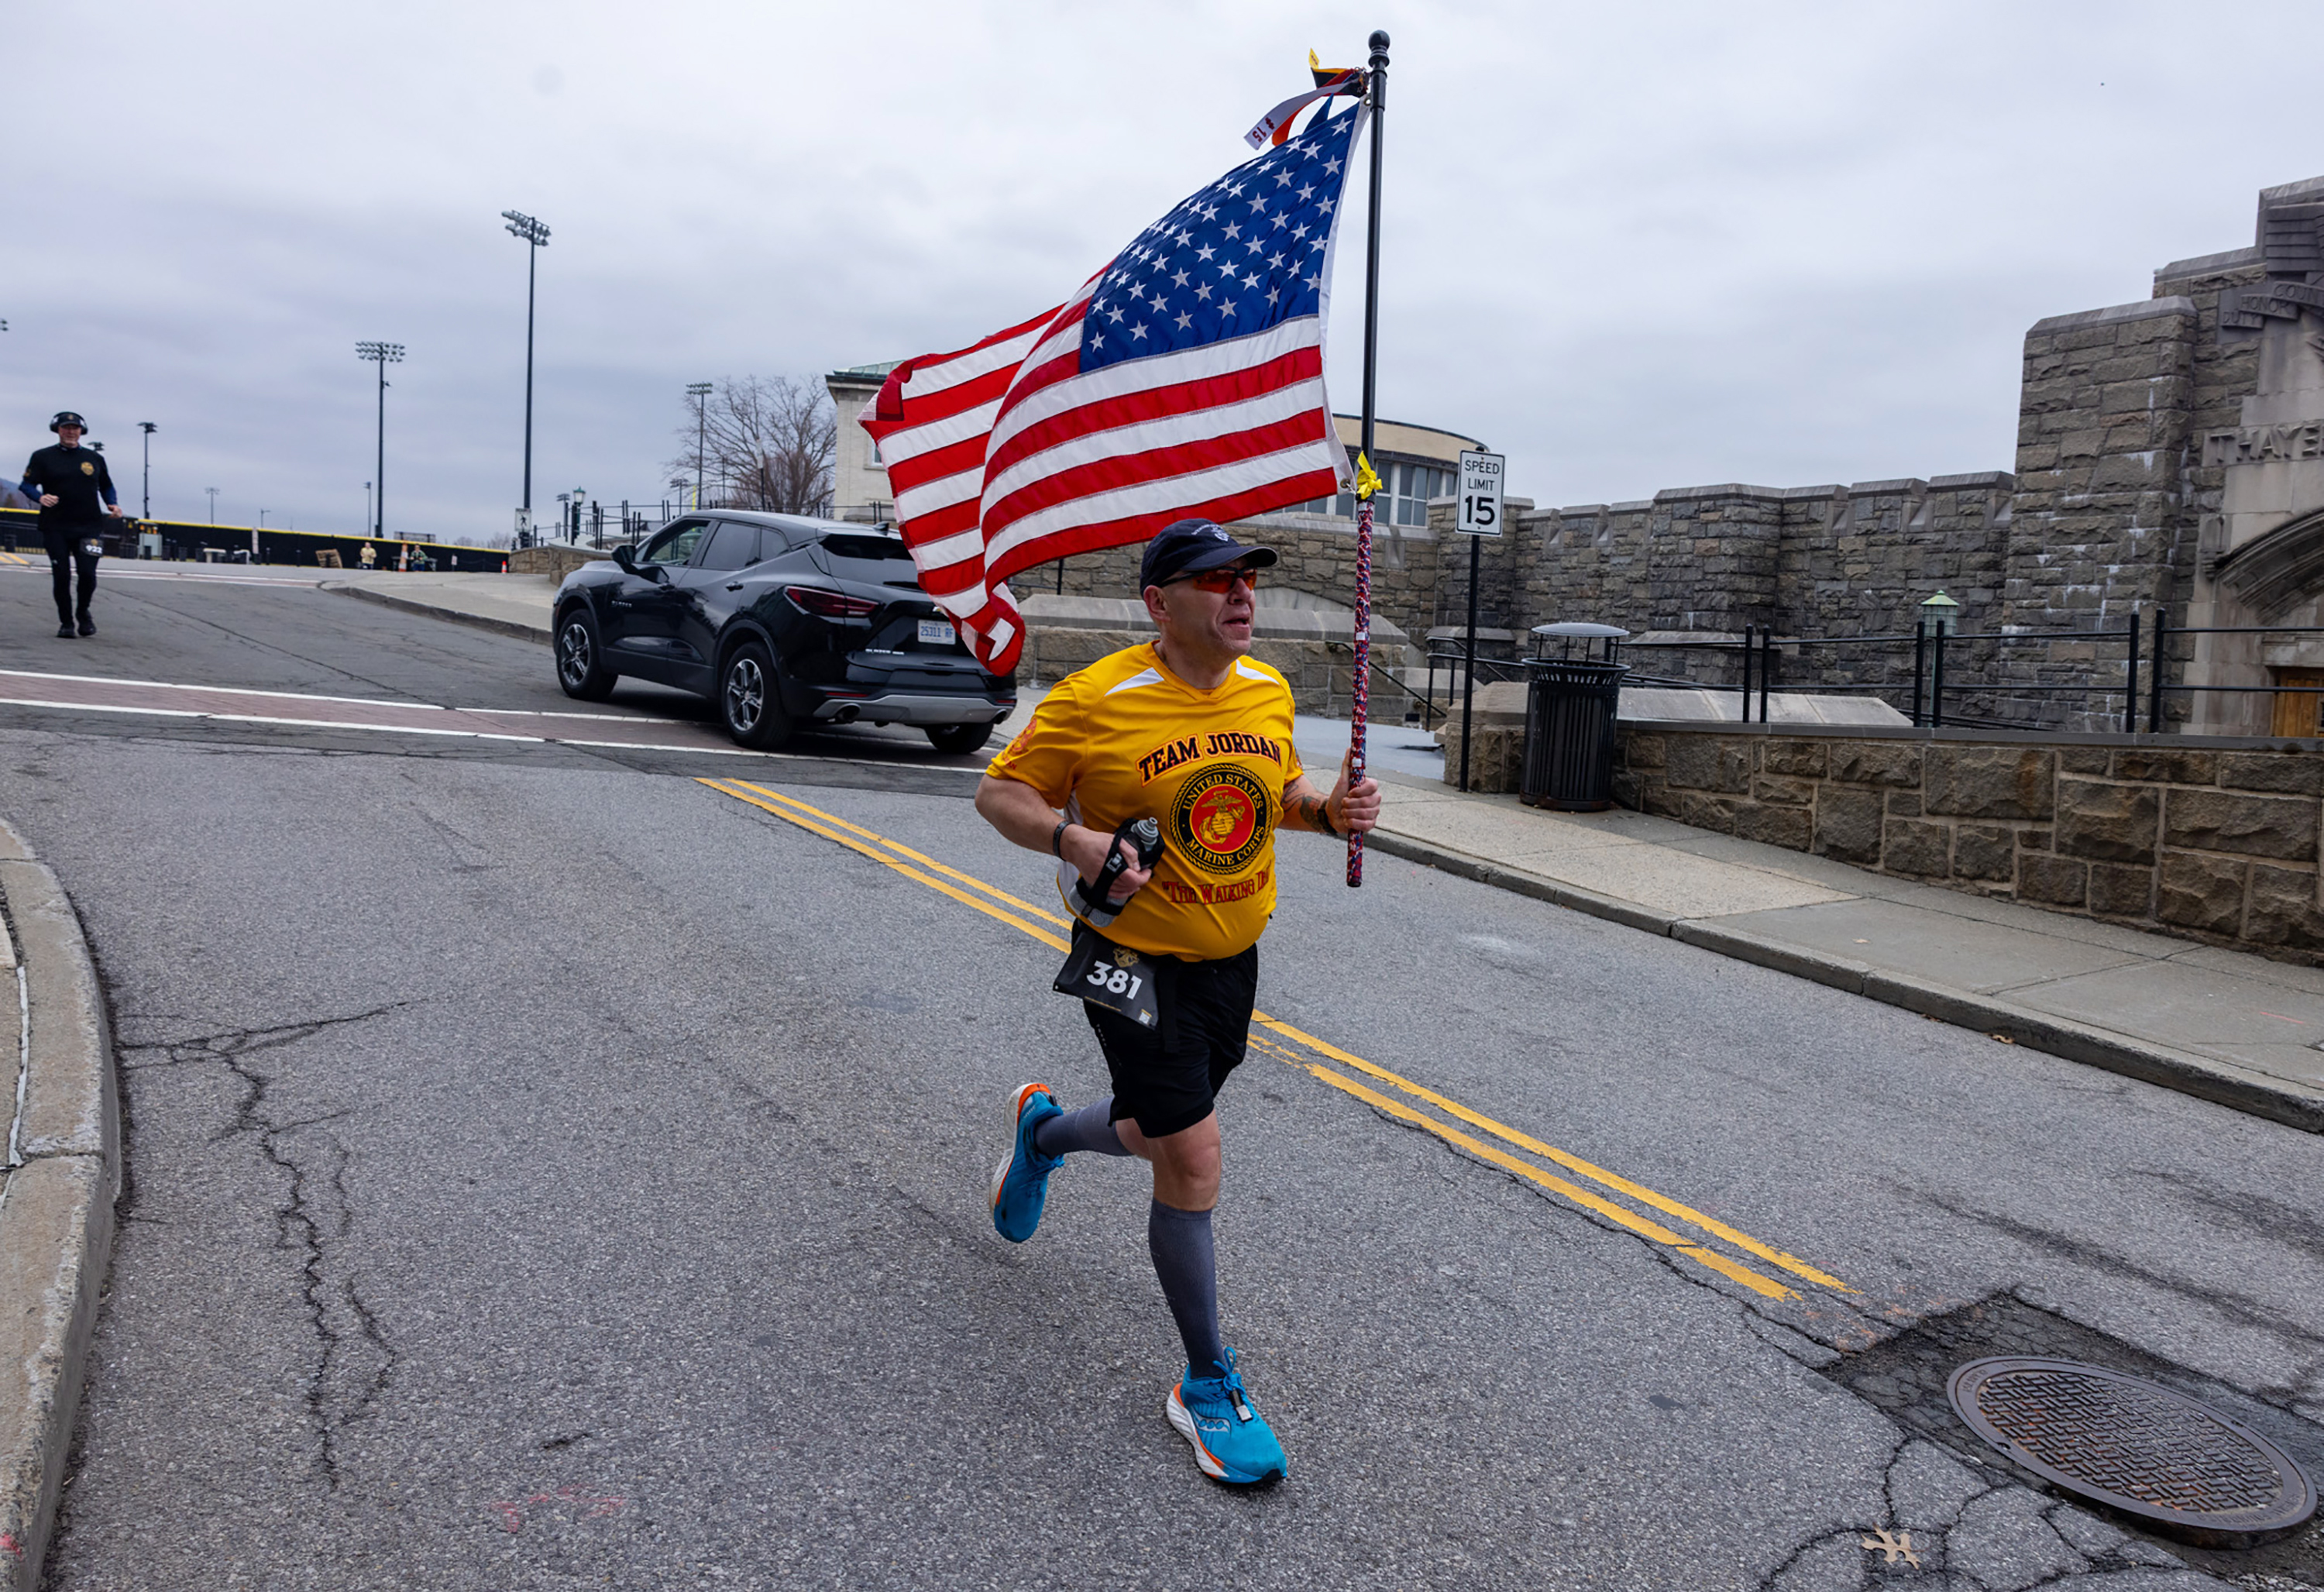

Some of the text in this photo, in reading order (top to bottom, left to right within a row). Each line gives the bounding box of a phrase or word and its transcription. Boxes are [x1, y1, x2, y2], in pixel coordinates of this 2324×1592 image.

[2223, 311, 2260, 325] DUTY
[2241, 296, 2290, 315] HONOR
[2209, 423, 2324, 462] THAYE
[1464, 459, 1500, 475] SPEED
[1467, 477, 1495, 491] LIMIT
[1465, 495, 1495, 525] 15
[1137, 731, 1282, 785] TEAM JORDAN
[1182, 774, 1263, 810] UNITED STATES
[1187, 825, 1265, 865] MARINE CORPS
[1198, 879, 1255, 905] WALKING
[1086, 960, 1143, 1000] 381
